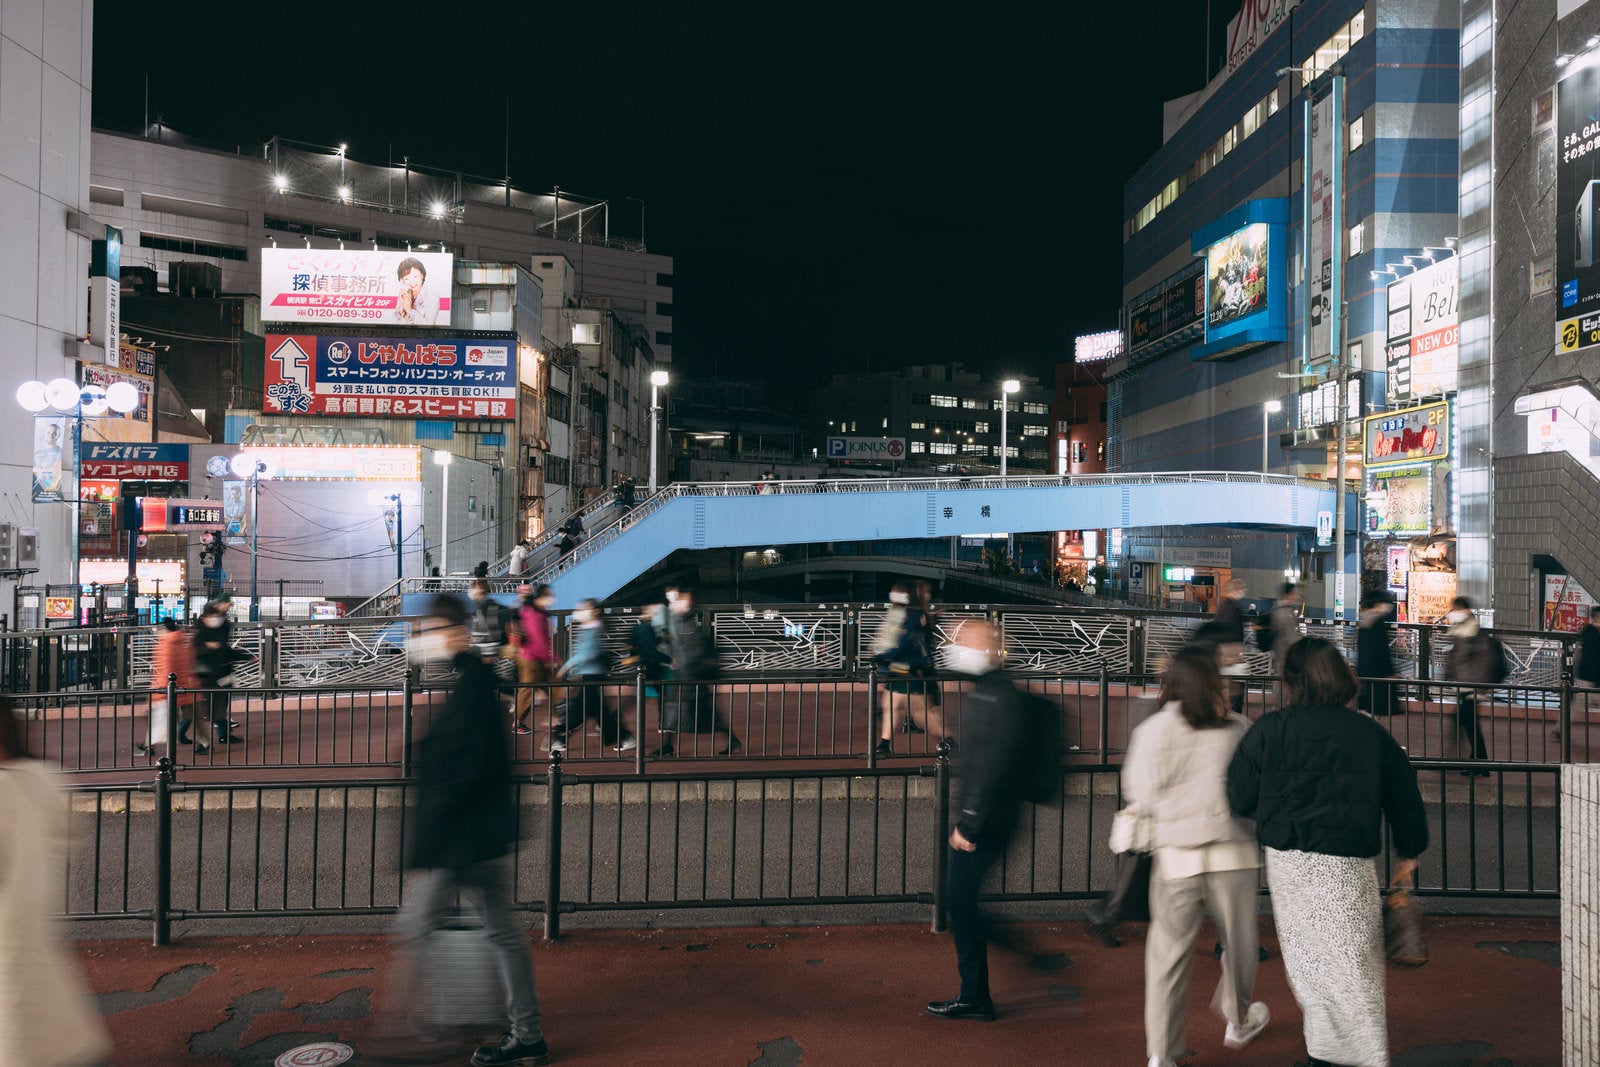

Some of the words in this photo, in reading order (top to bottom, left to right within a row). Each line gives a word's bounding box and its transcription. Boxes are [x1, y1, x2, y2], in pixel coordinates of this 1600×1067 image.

[1228, 35, 1258, 73] SOTETSU
[292, 273, 386, 293] 探偵事務所
[324, 296, 374, 307] スカイビル
[307, 308, 383, 319] 0120-089-390
[1416, 332, 1442, 354] NEW
[358, 342, 458, 367] じゃんぱら
[327, 366, 506, 382] スマートフォン・パソコン・オーディオ
[268, 384, 300, 396] この先
[332, 384, 500, 398] 分割支払い中のスマホも買取OK!!
[279, 395, 312, 413] すぐ
[1428, 409, 1445, 426] 2F
[91, 445, 159, 459] ドスパラ
[832, 440, 844, 453] P
[80, 486, 97, 502] 2F
[188, 509, 220, 522] 西口五番街
[1132, 565, 1141, 578] P
